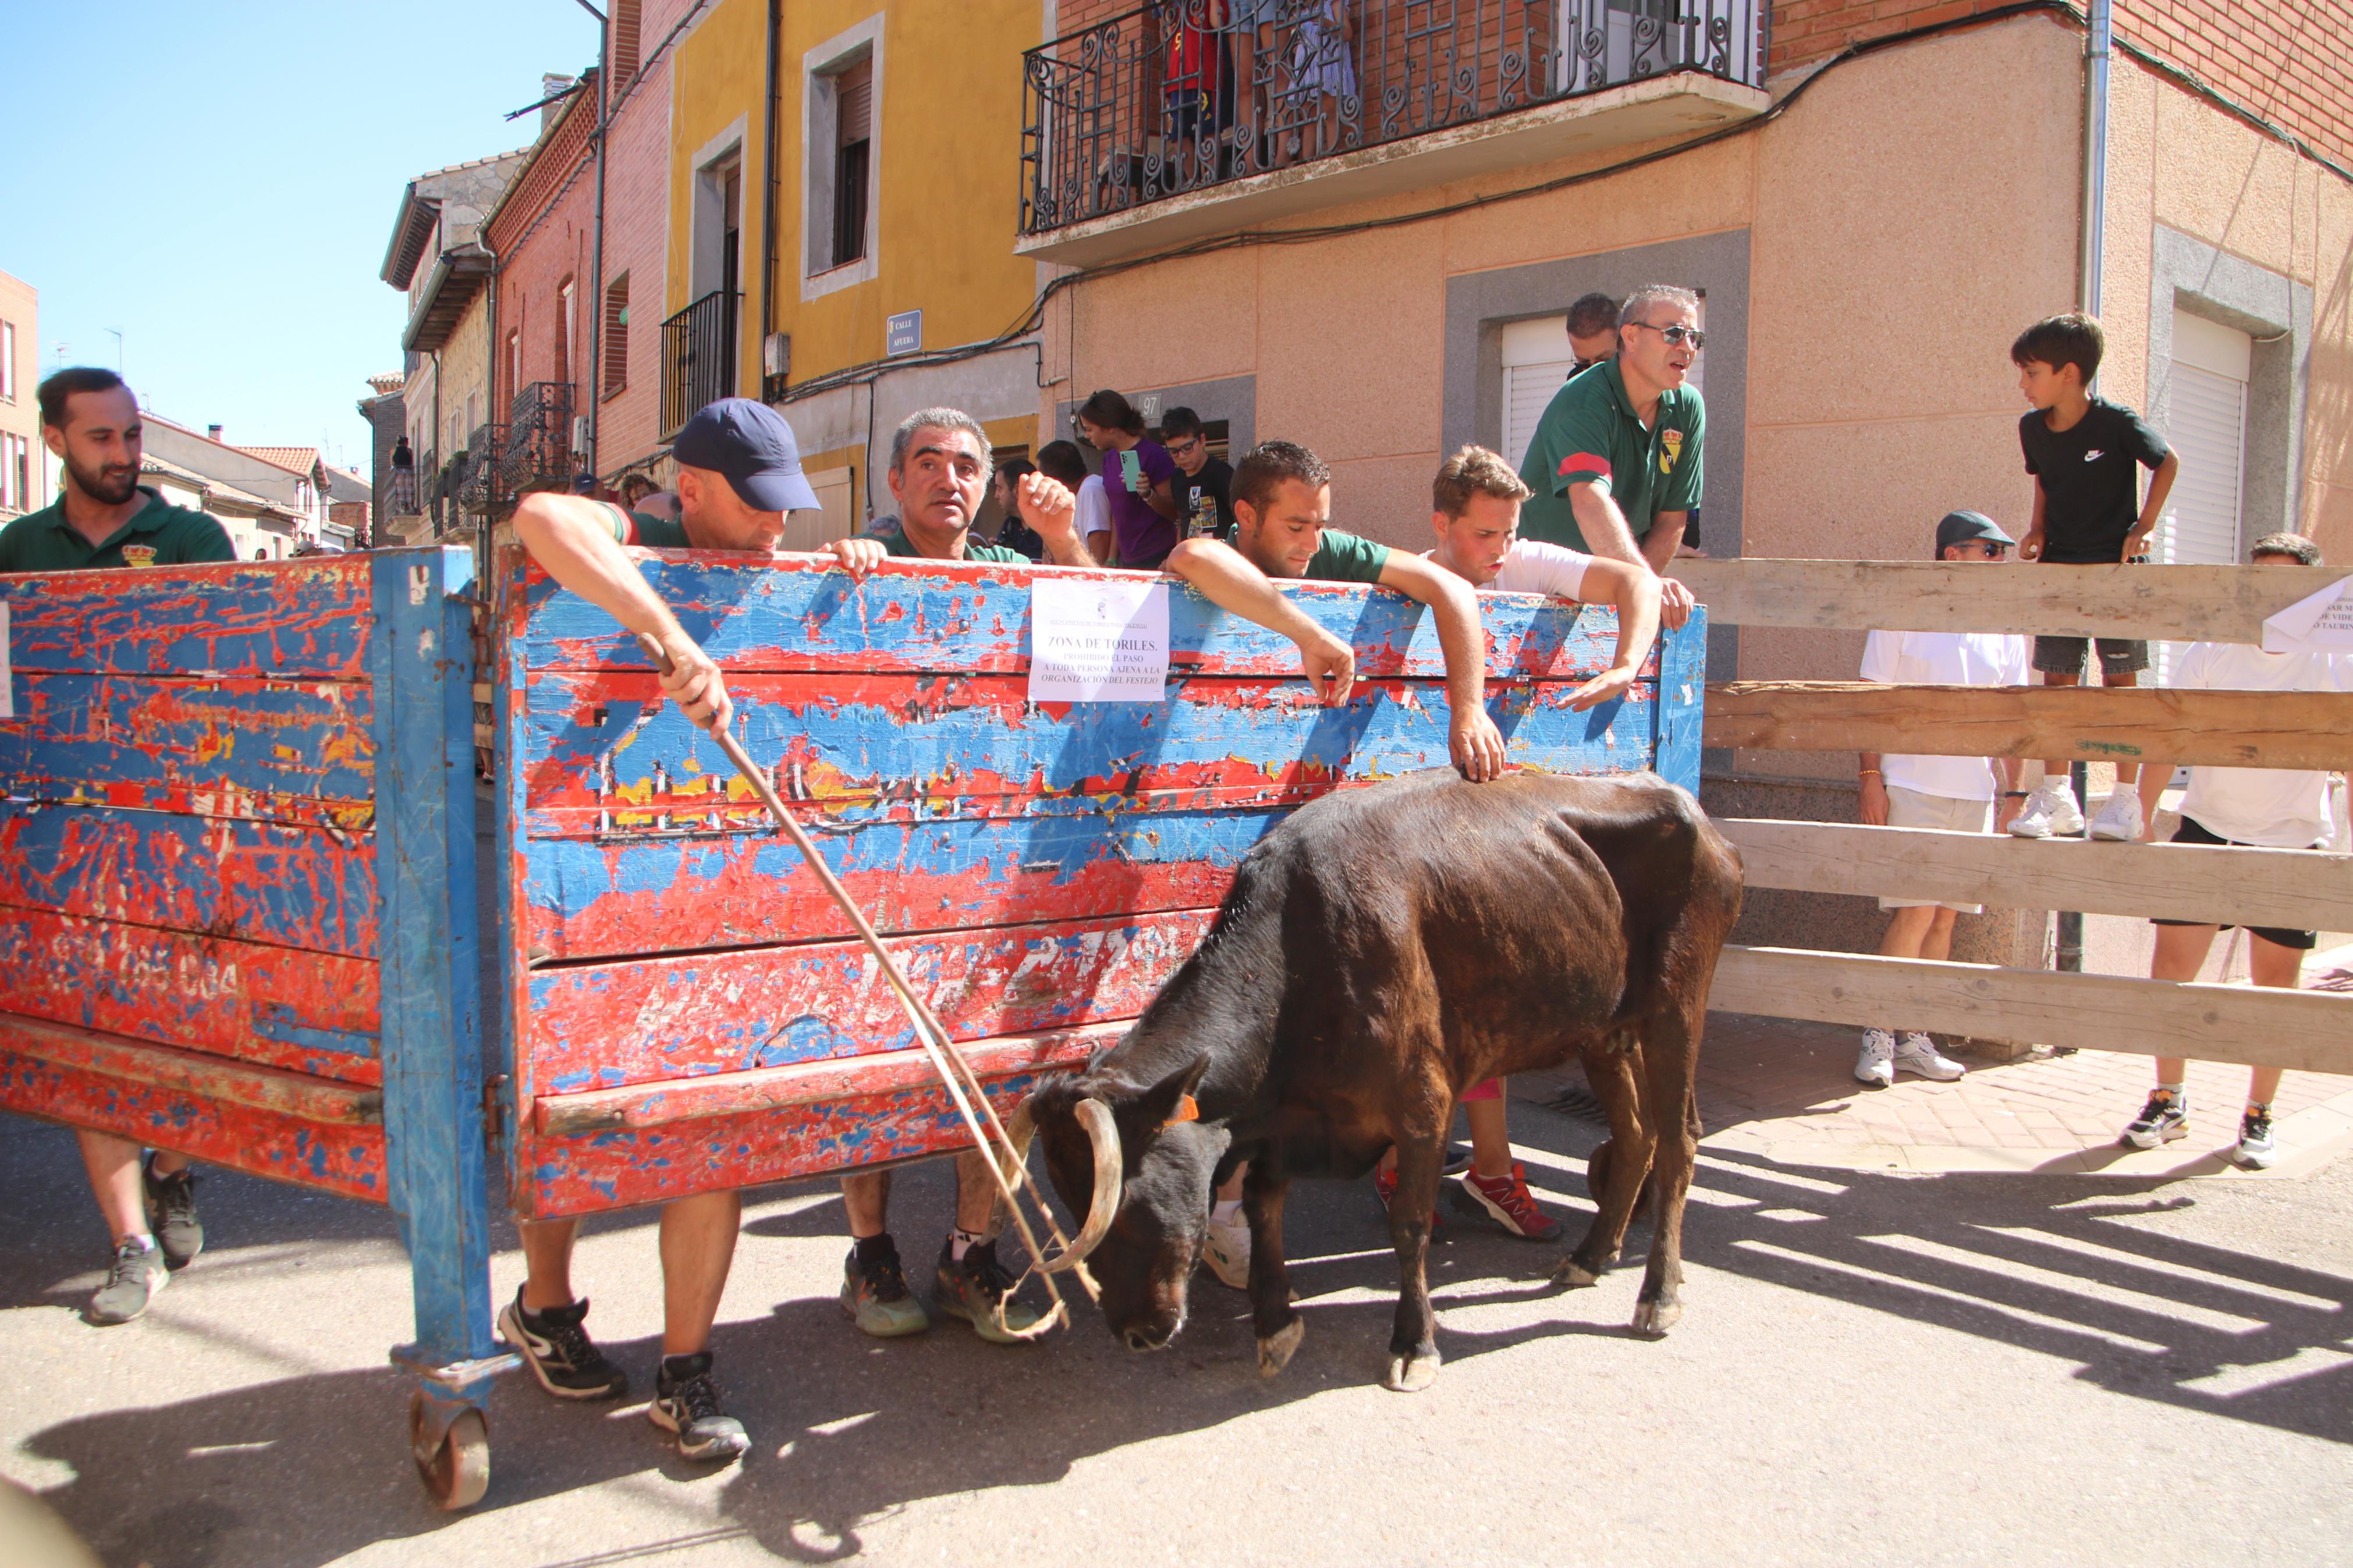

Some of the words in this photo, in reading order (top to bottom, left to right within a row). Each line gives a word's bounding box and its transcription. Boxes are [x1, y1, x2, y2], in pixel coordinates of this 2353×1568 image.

[895, 319, 912, 330] CALLE
[894, 336, 914, 346] AFUERA
[1144, 397, 1156, 415] 97
[1048, 637, 1081, 648] ZONA
[1085, 638, 1101, 649] DE
[1103, 639, 1158, 651] TORILES.
[1064, 653, 1109, 661] PROHIBIDO
[1052, 663, 1075, 671] TODA
[1077, 664, 1114, 673] PERSONA
[1116, 666, 1141, 674] AJENA
[1041, 674, 1107, 684] ORGANIZACIÓN
[1126, 676, 1158, 684] FESTEJO
